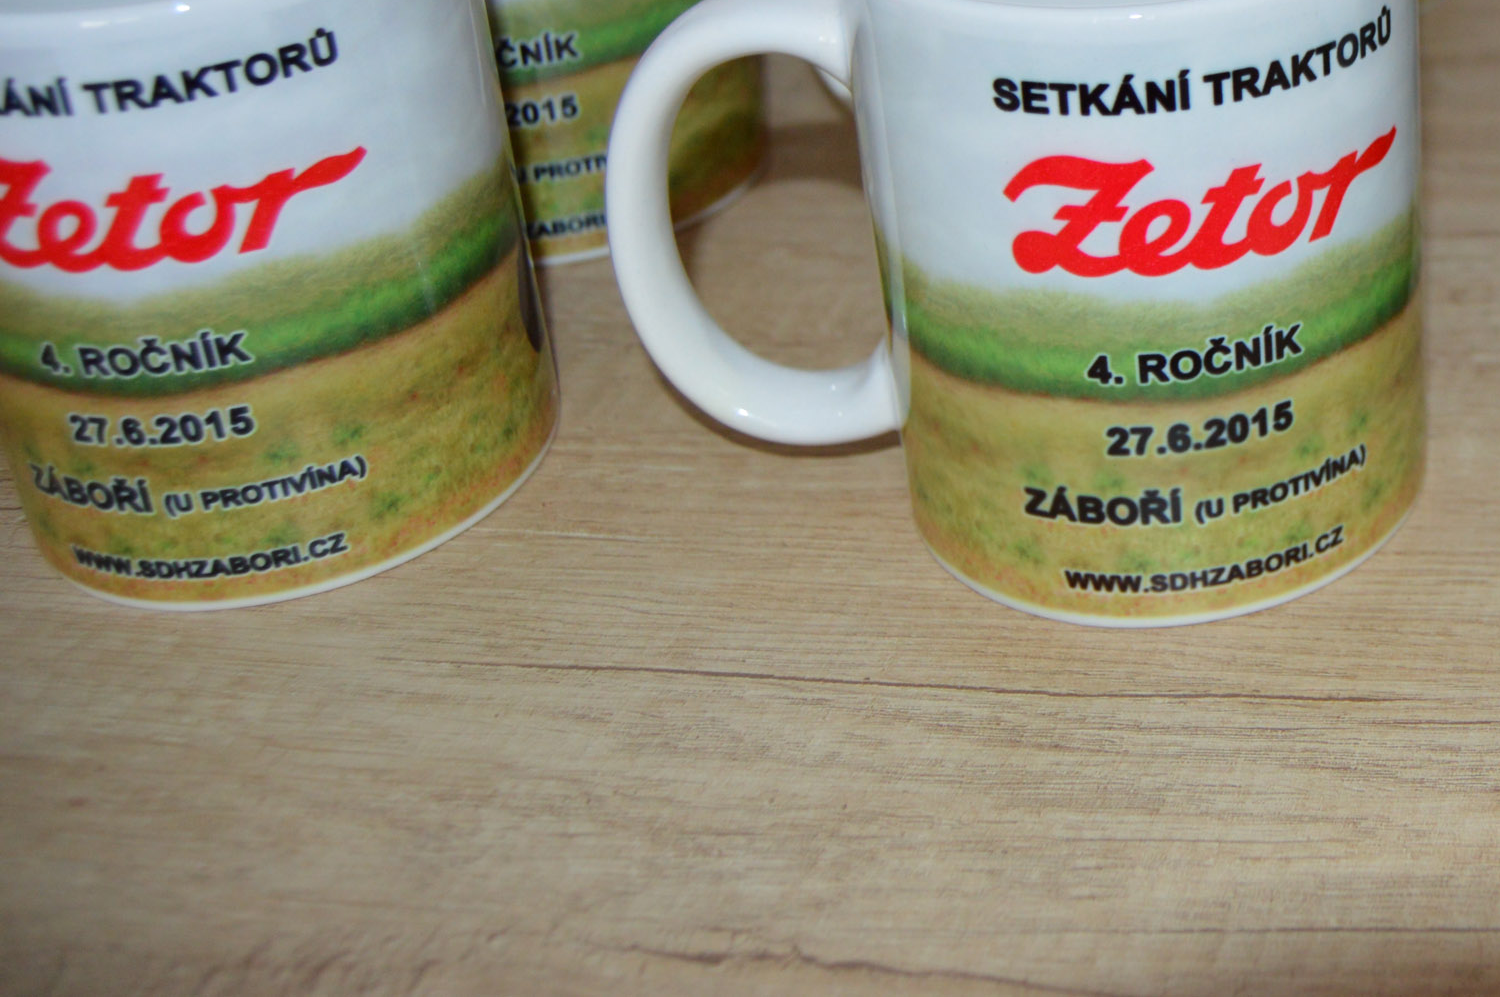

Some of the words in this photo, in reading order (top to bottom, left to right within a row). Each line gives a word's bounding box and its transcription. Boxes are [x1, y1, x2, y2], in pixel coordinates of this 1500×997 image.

[81, 27, 339, 114] TRAKTORŮ
[991, 69, 1191, 117] SETKÁNÍ
[1203, 5, 1392, 106] TRAKTORŮ
[1002, 124, 1397, 278] Zetor
[40, 344, 72, 374] 4.
[78, 331, 252, 377] ROČNÍK
[1086, 354, 1125, 385] 4.
[1137, 323, 1304, 384] ROČNÍK
[68, 404, 255, 446] 27.6.2015
[1105, 399, 1295, 457] 27.6.2015
[28, 461, 154, 514] ZÁBOŘÍ
[163, 492, 194, 518] (U
[201, 454, 368, 511] PROTIVÍNA)
[1023, 485, 1183, 527] ZÁBOŘÍ
[1194, 497, 1225, 524] (U
[1231, 443, 1368, 514] PROTIVÍNA)
[73, 532, 348, 580] WWW.SDHZABORI.CZ
[1064, 525, 1345, 594] WWW.SDHZABORI.CZ
